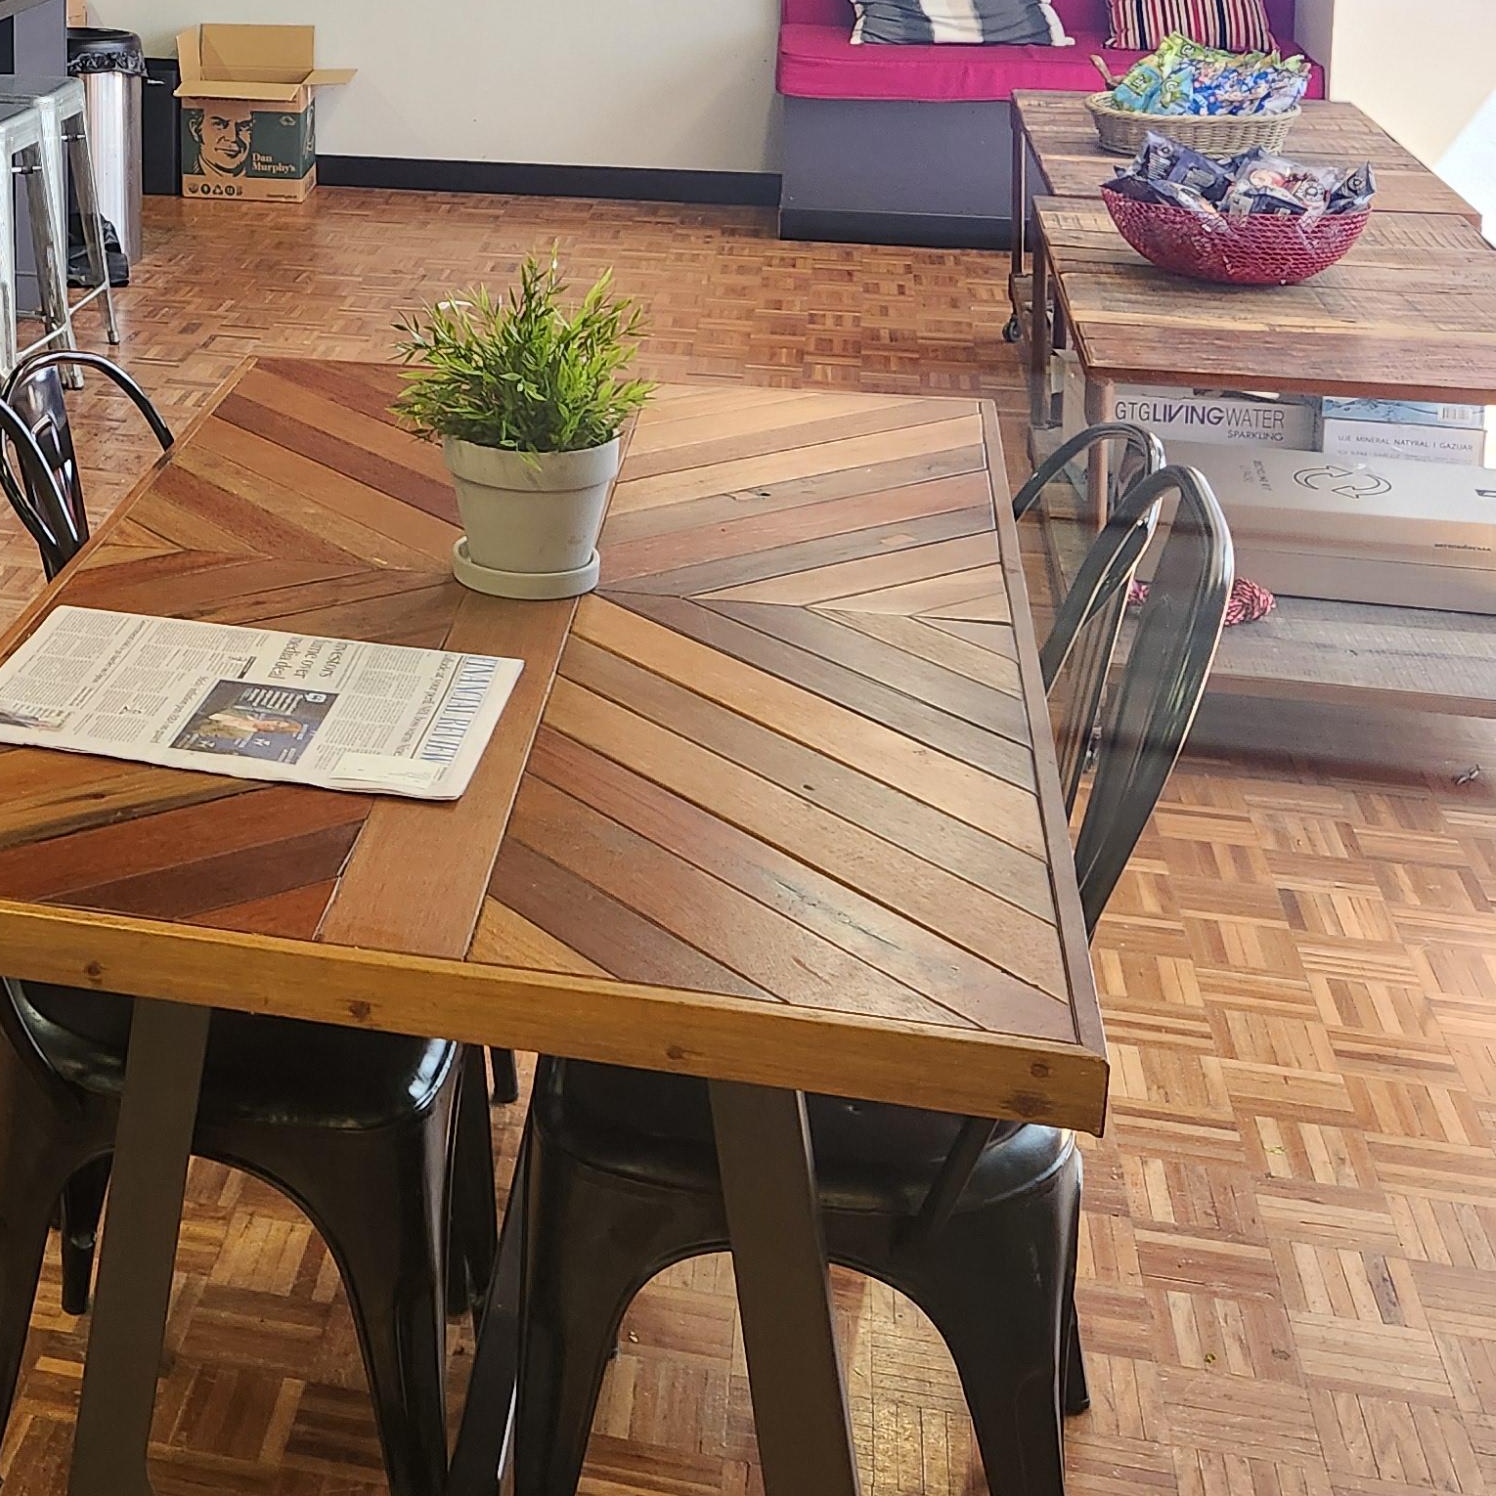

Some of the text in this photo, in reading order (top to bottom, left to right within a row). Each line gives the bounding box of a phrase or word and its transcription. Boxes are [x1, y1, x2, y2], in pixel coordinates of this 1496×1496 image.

[252, 153, 272, 162] Dan
[251, 163, 296, 174] Murphy's
[1227, 429, 1285, 442] SPARKLING
[1356, 436, 1390, 446] MINERAL
[267, 661, 292, 679] deal
[294, 659, 314, 679] over
[419, 656, 499, 762] FINANCIAL REVIEW
